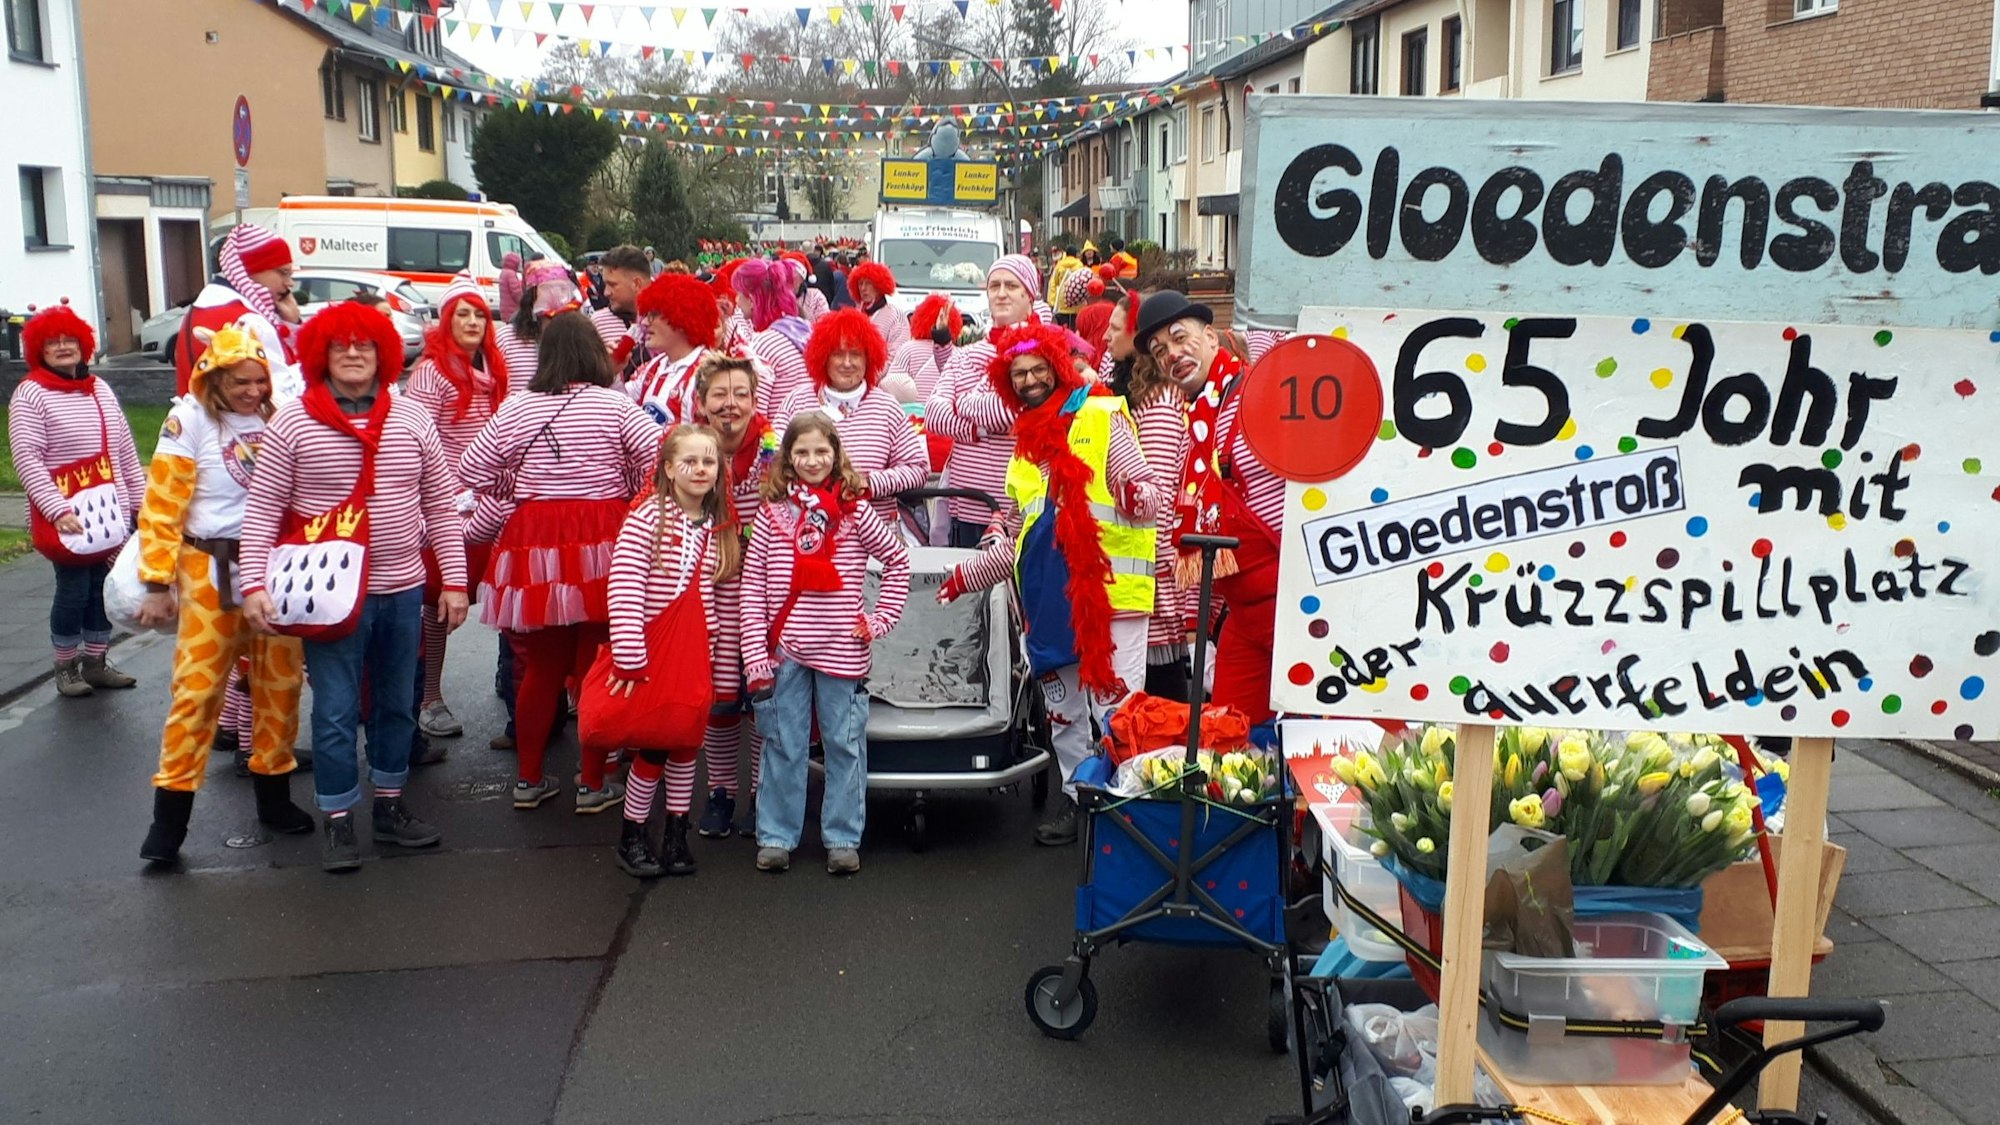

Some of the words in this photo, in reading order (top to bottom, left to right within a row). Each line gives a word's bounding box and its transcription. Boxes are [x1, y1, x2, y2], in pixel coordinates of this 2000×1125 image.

[320, 238, 379, 252] Malteser
[1278, 374, 1344, 422] 10
[1392, 317, 1577, 449] 65
[1636, 323, 1898, 451] Johr
[1318, 456, 1680, 576] Gloedenstroß
[1738, 449, 1911, 522] mit
[1414, 547, 1970, 634] Krüzzspillplatz
[1315, 637, 1423, 704] oder
